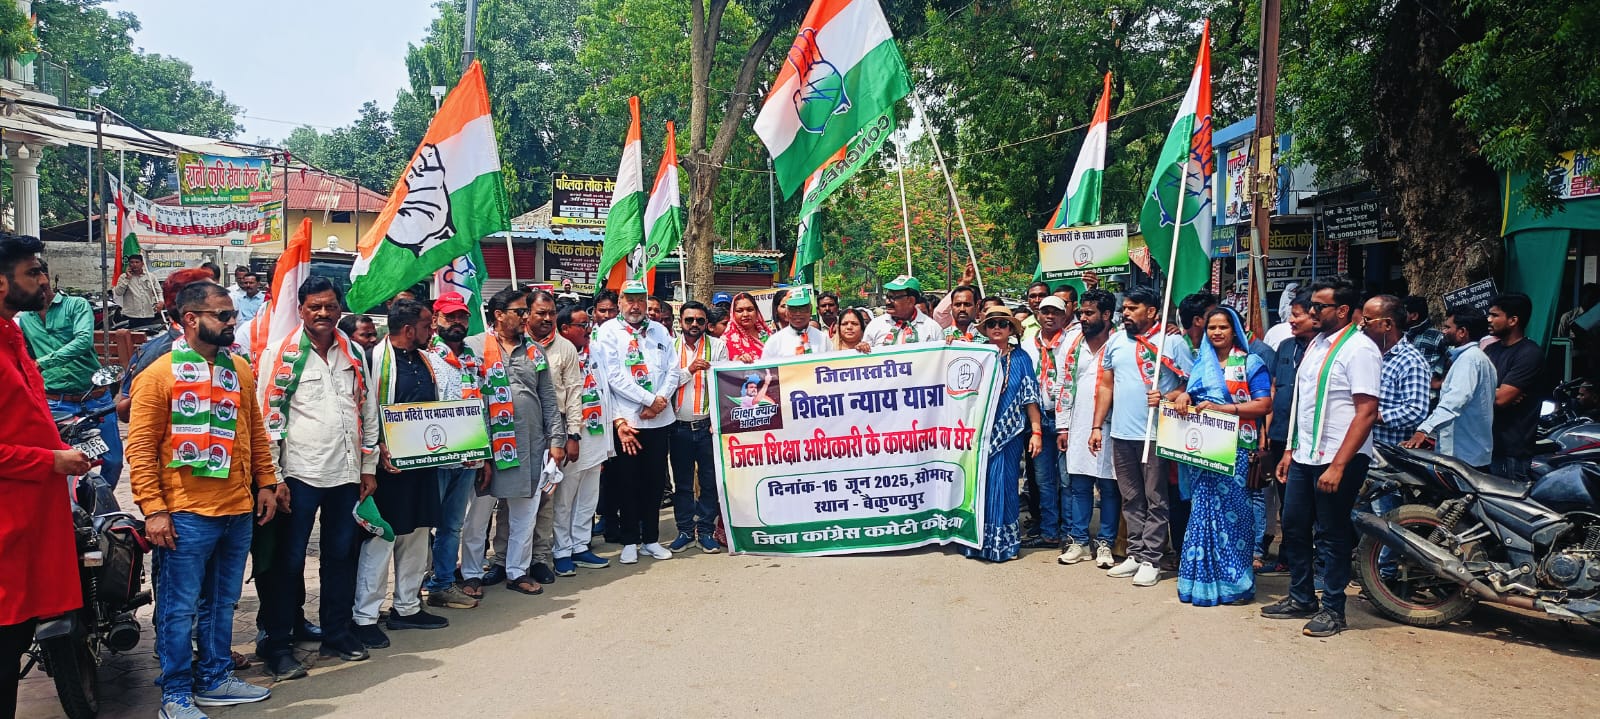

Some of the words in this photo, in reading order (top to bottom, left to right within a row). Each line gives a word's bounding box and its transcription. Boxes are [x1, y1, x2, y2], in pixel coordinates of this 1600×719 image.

[185, 158, 206, 189] रानी
[207, 159, 226, 194] कृषि
[227, 161, 241, 189] सेवा
[555, 174, 585, 191] पब्लिक
[585, 177, 604, 192] लोक
[604, 178, 617, 192] सेव
[1074, 230, 1081, 240] के
[1082, 231, 1095, 240] साथ
[575, 243, 594, 257] लोक
[815, 360, 912, 384] जिलास्तरीय
[790, 390, 844, 420] शिक्षा
[848, 389, 898, 413] न्याय
[902, 384, 945, 409] यात्रा
[384, 409, 404, 423] शिक्षा
[404, 407, 424, 422] मंदिरों
[424, 409, 433, 420] पर
[433, 407, 455, 419] भाजपा
[455, 406, 465, 417] का
[465, 405, 481, 416] प्रहार
[731, 406, 755, 421] शिक्षा
[755, 404, 778, 416] न्याय
[728, 435, 763, 468] जिला
[764, 432, 801, 465] शिक्षा
[803, 425, 863, 462] अधिकारी
[864, 424, 881, 456] के
[882, 419, 938, 455] कार्यालय
[395, 459, 415, 467] जिला
[416, 456, 439, 465] कांग्रेस
[439, 453, 460, 462] कमेटी
[844, 476, 871, 495] जून
[814, 499, 849, 513] स्थान
[751, 530, 799, 545] जिला
[801, 525, 861, 541] कांग्रेस
[863, 518, 919, 537] कमेटी
